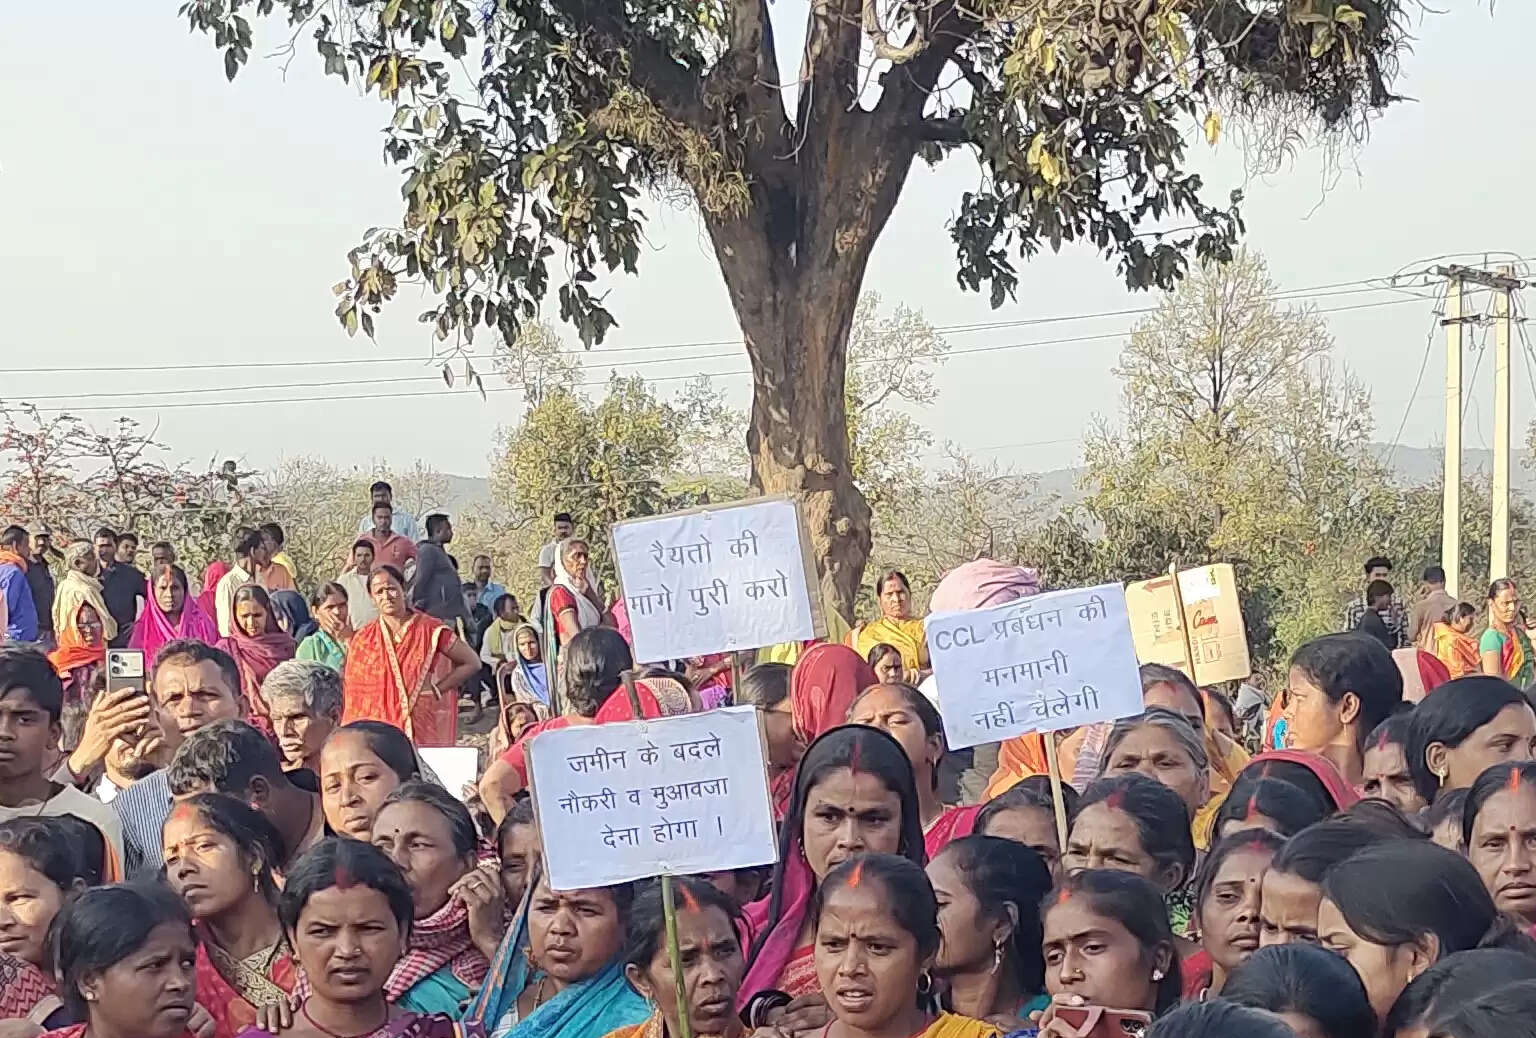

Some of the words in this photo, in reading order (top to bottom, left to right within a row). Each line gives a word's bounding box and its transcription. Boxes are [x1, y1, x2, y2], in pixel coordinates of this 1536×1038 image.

[649, 533, 713, 569] रैयतो
[726, 529, 759, 559] की
[688, 578, 729, 617] पुरी
[743, 569, 789, 601] करो
[935, 623, 986, 651] CCL
[991, 605, 1064, 641] प्रबंधन
[1075, 594, 1108, 622] की
[982, 649, 1069, 687] मनमानी
[970, 700, 1015, 730] नहीं
[566, 746, 627, 774] जमीन
[637, 740, 660, 766] के
[669, 731, 722, 762] बदले
[558, 787, 617, 815] नौकरी
[626, 789, 642, 806] व
[651, 777, 729, 810] मुआवजा
[600, 824, 641, 849] देना
[651, 815, 698, 844] होगा
